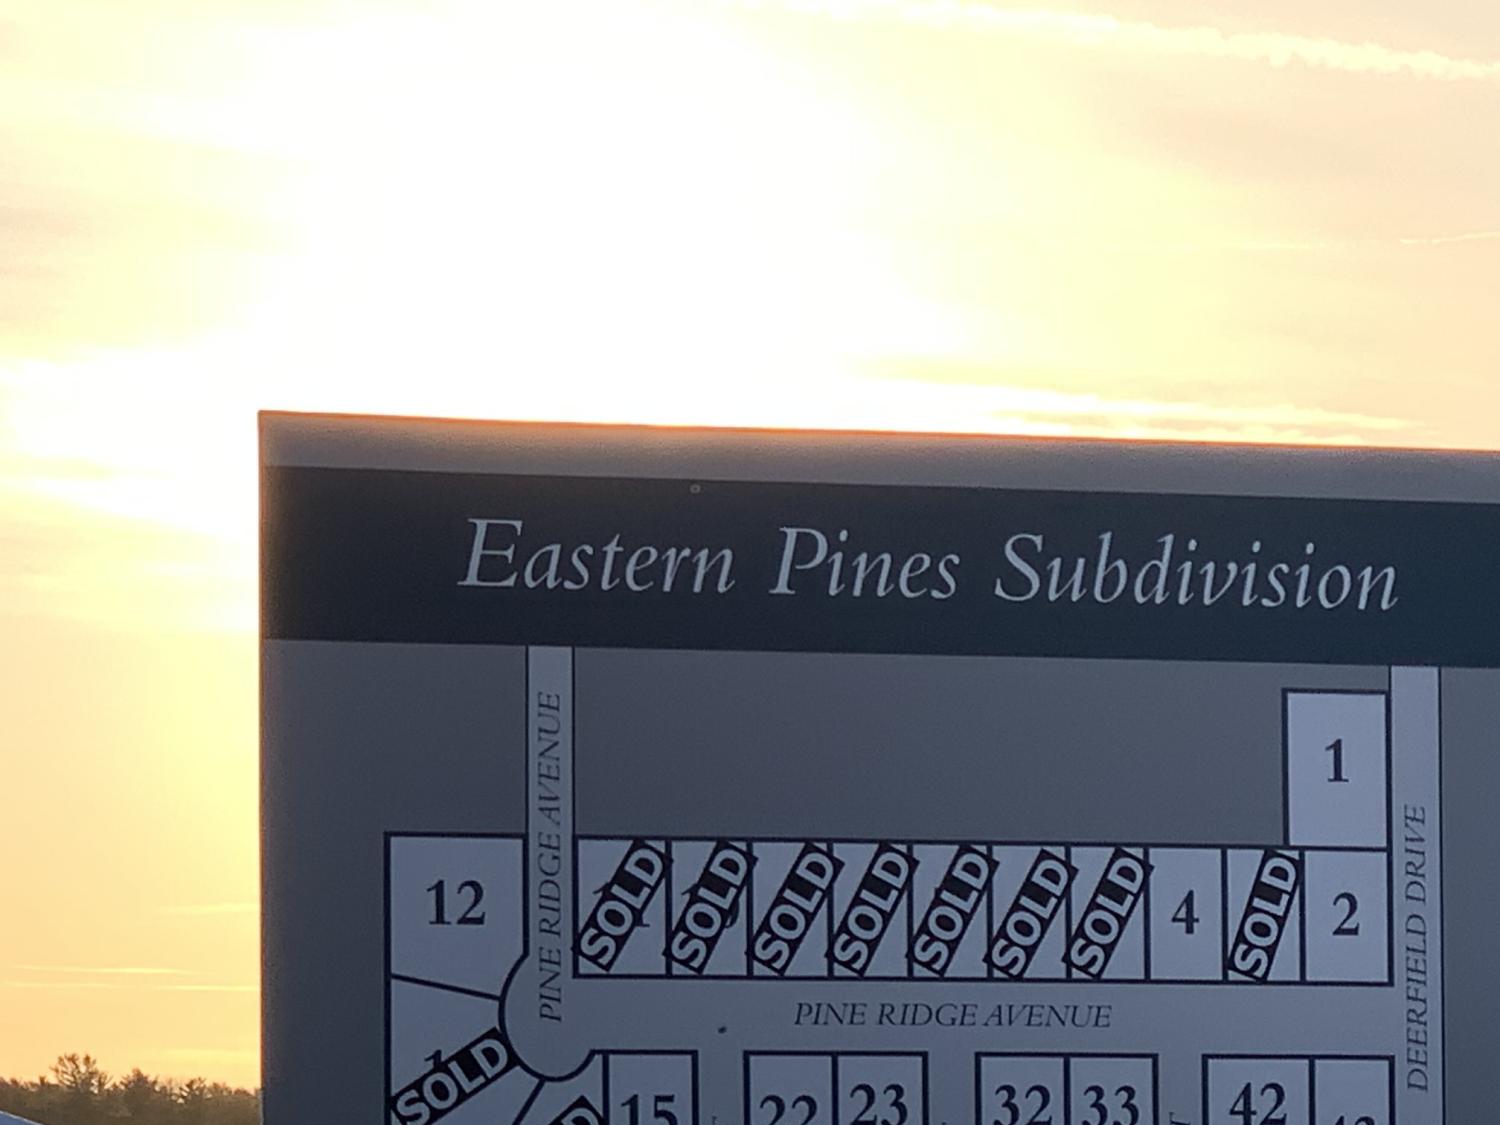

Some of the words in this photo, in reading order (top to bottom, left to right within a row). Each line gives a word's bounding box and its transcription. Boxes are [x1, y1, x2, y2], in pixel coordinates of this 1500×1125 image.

[457, 517, 736, 593] Eastern
[769, 527, 961, 600] Pines
[994, 531, 1399, 611] Subdivision
[537, 691, 561, 826] AVENUE
[1324, 738, 1350, 783] 1
[426, 880, 487, 926] 12
[537, 832, 562, 938] RIDGE
[580, 847, 664, 967] SOLD
[671, 848, 748, 969] SOLD
[754, 851, 834, 971] SOLD
[833, 851, 909, 971] SOLD
[912, 851, 990, 971] SOLD
[1171, 889, 1200, 935] 4
[1404, 803, 1426, 906] DRIVE
[992, 858, 1069, 976] SOLD
[1070, 856, 1145, 974] SOLD
[1234, 856, 1297, 979] SOLD
[1332, 892, 1360, 937] 2
[538, 947, 562, 1022] PINE
[794, 1001, 867, 1027] PINE
[876, 1002, 977, 1027] RIDGE
[982, 1004, 1112, 1029] AVENUE
[1406, 913, 1428, 1093] DEERFIELD
